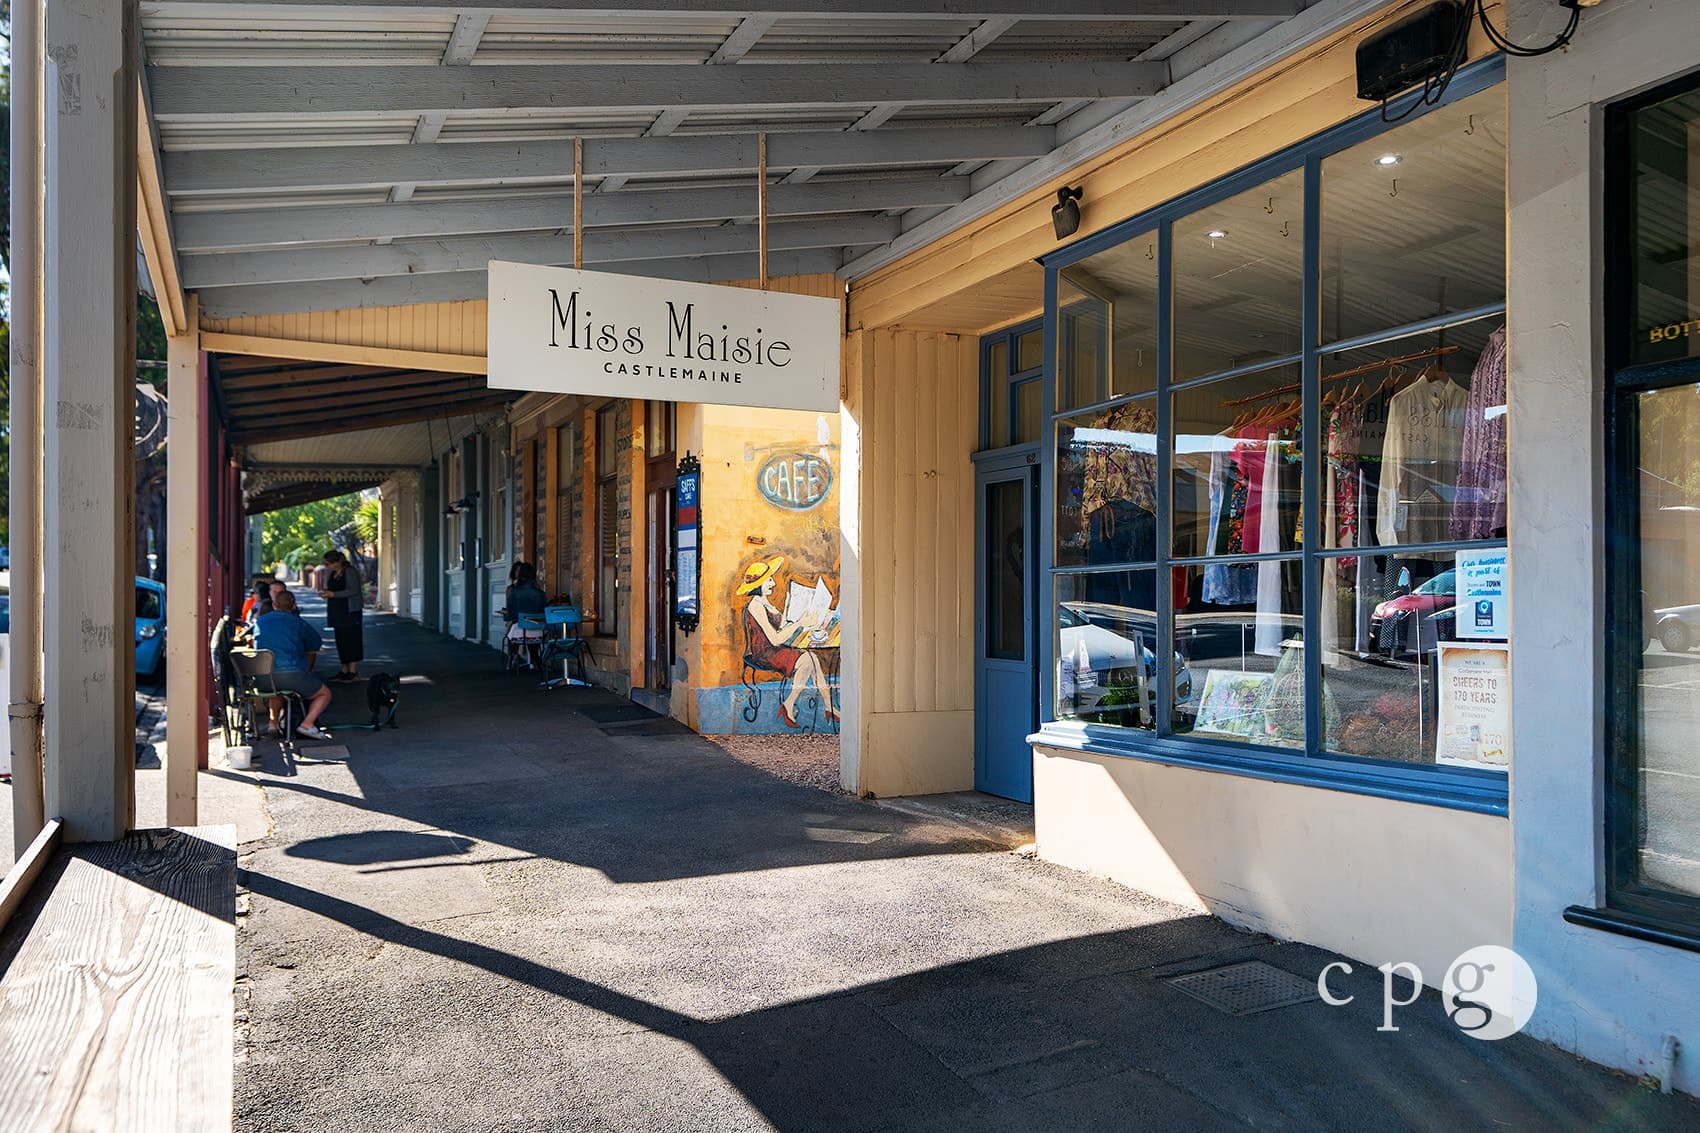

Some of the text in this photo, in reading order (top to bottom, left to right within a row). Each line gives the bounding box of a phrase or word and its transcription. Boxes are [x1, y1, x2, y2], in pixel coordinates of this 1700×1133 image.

[548, 288, 792, 367] Miss Maisie
[603, 362, 742, 384] CASTLEMAINE
[764, 459, 820, 503] CAFE
[1453, 676, 1498, 690] CHEERS TO
[1470, 691, 1498, 705] YEARS
